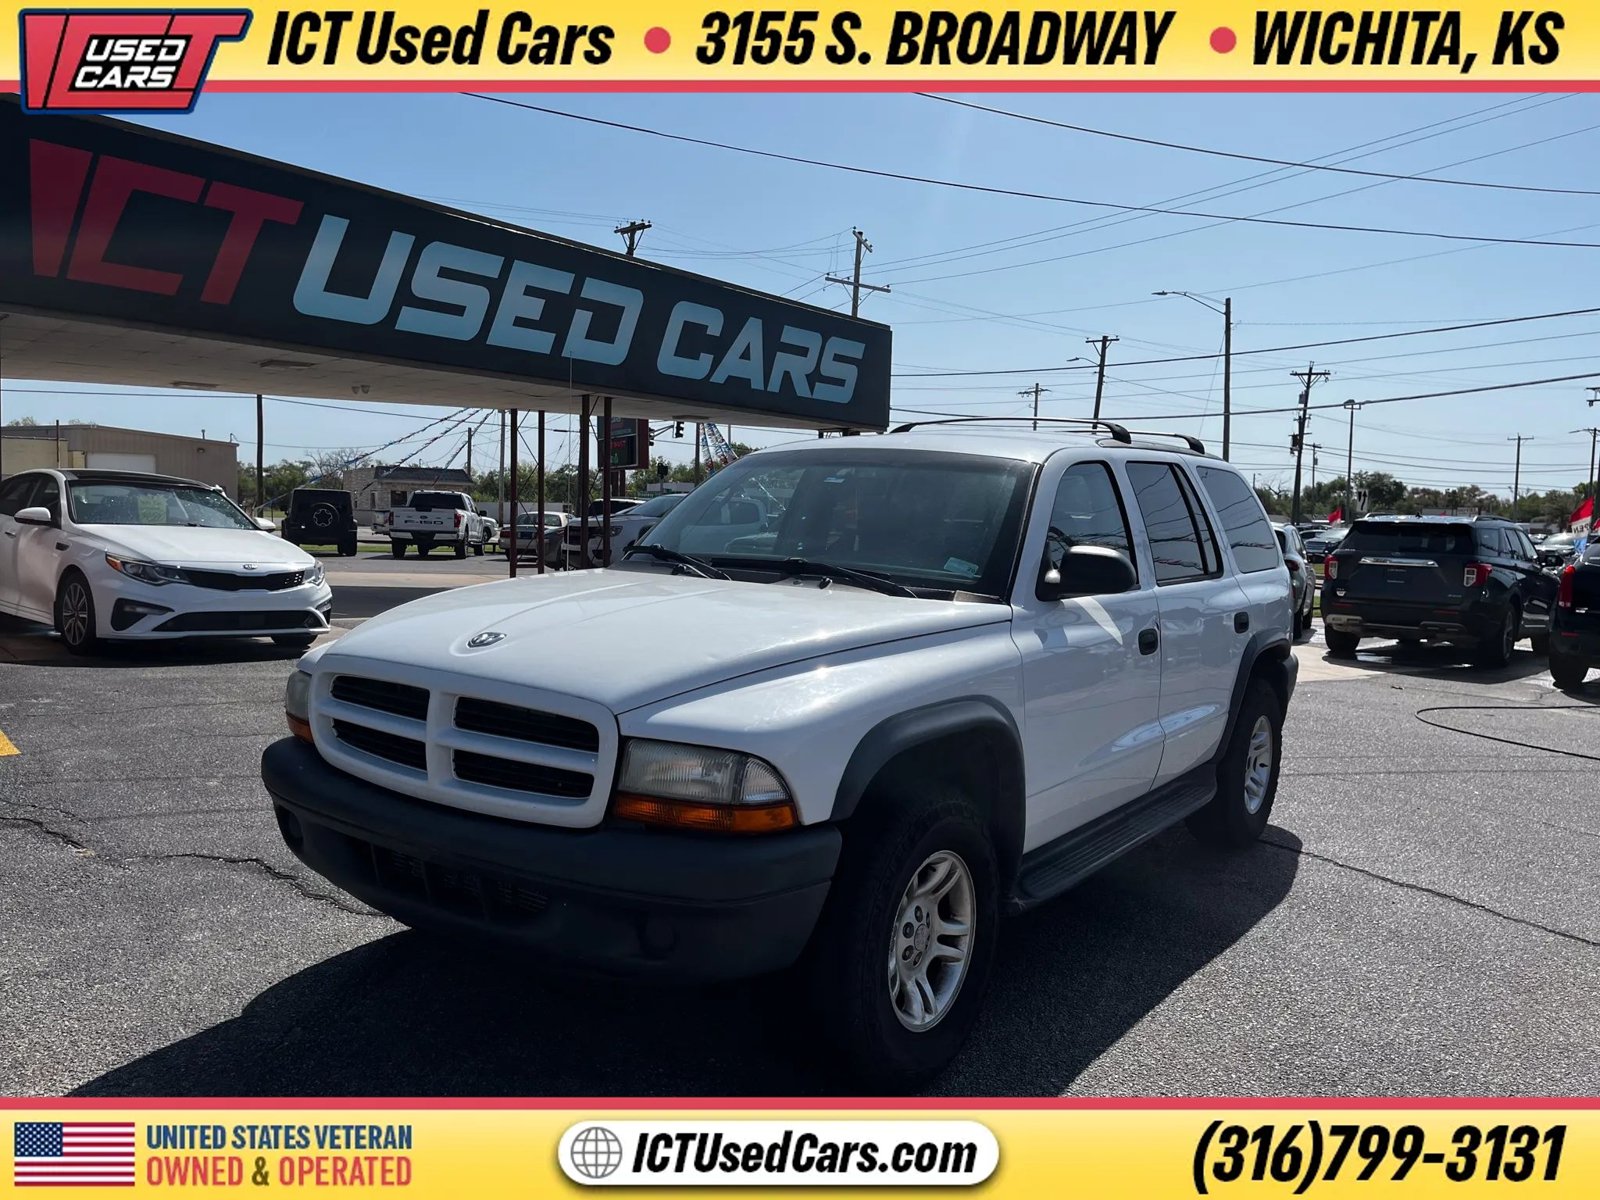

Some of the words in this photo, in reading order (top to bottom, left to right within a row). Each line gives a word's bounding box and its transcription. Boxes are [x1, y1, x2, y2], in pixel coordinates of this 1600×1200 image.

[29, 138, 305, 306] ICT
[293, 213, 645, 366] USED
[656, 300, 867, 404] CARS
